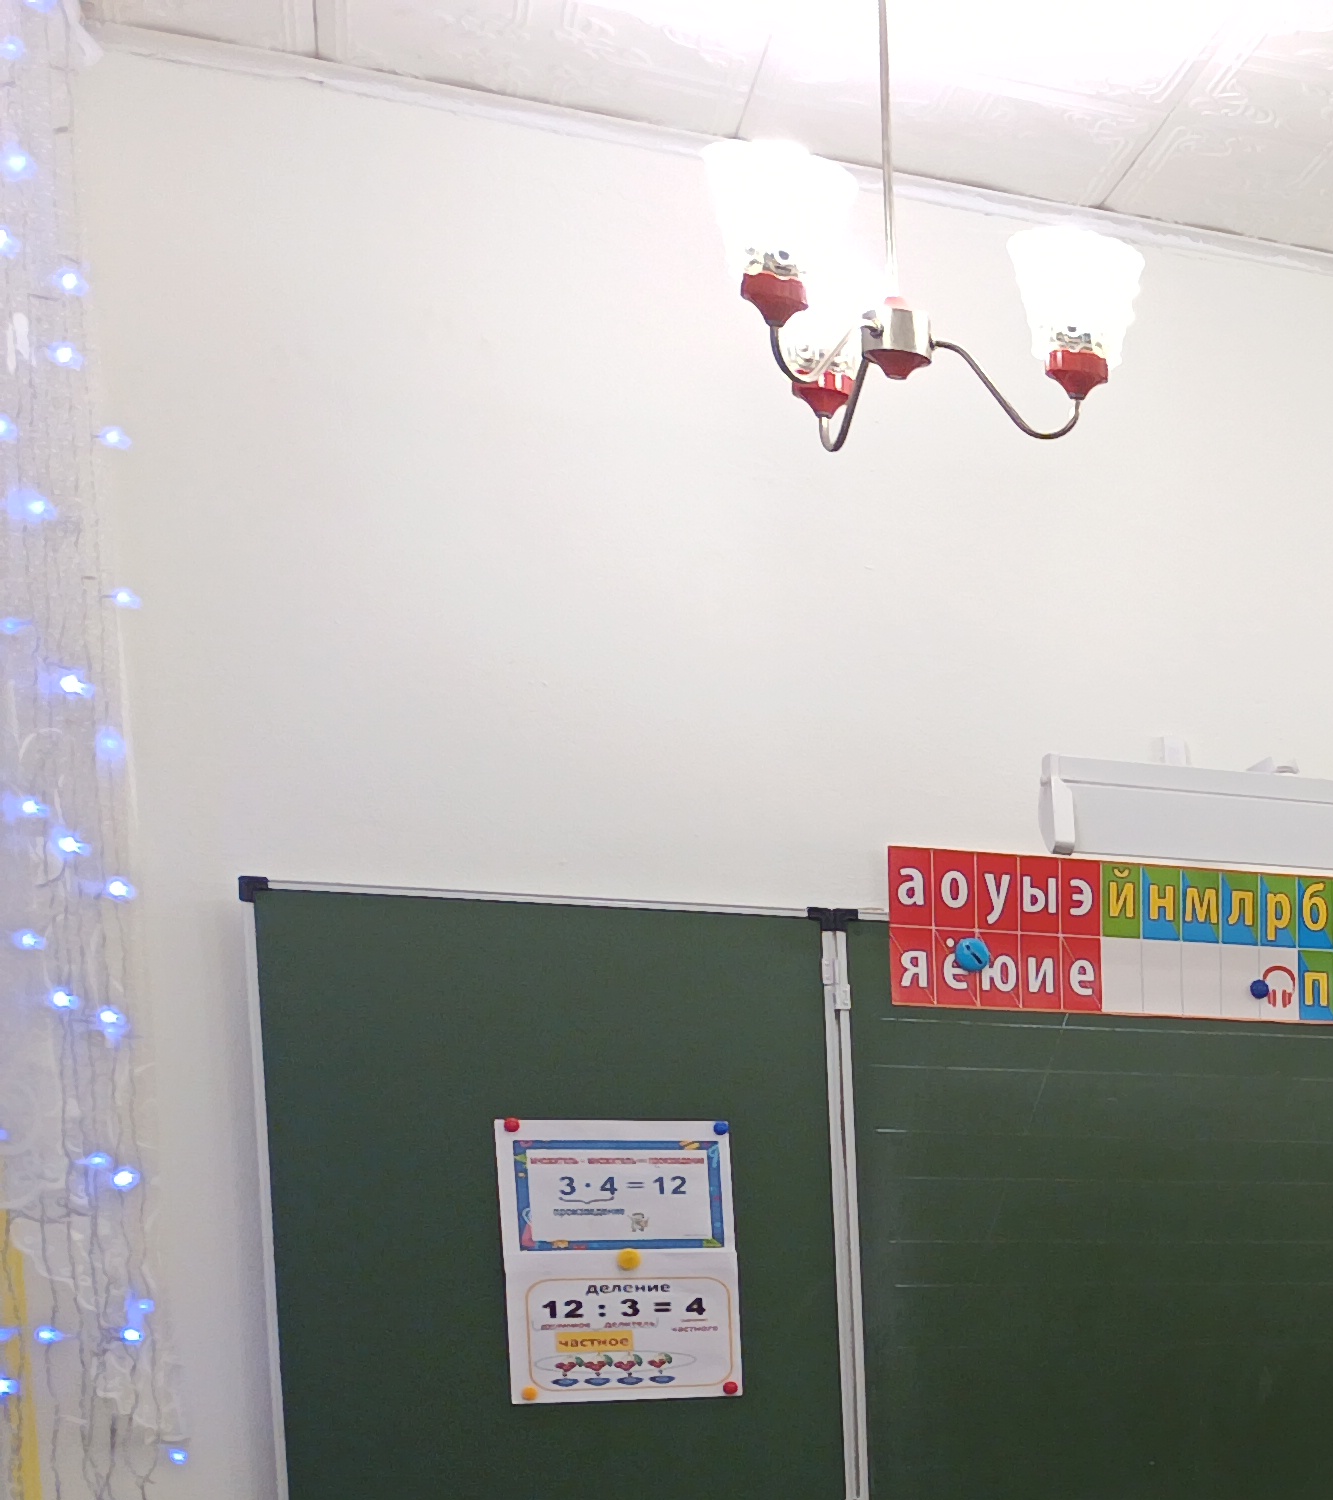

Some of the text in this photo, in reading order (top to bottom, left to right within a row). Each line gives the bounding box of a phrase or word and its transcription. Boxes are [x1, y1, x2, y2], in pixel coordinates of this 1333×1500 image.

[559, 1176, 576, 1196] 3
[600, 1176, 618, 1196] 4
[652, 1175, 687, 1195] 12
[586, 1283, 671, 1296] деление
[542, 1300, 584, 1319] 12
[621, 1299, 640, 1317] 3
[685, 1297, 706, 1316] 4
[558, 1337, 630, 1348] частное
